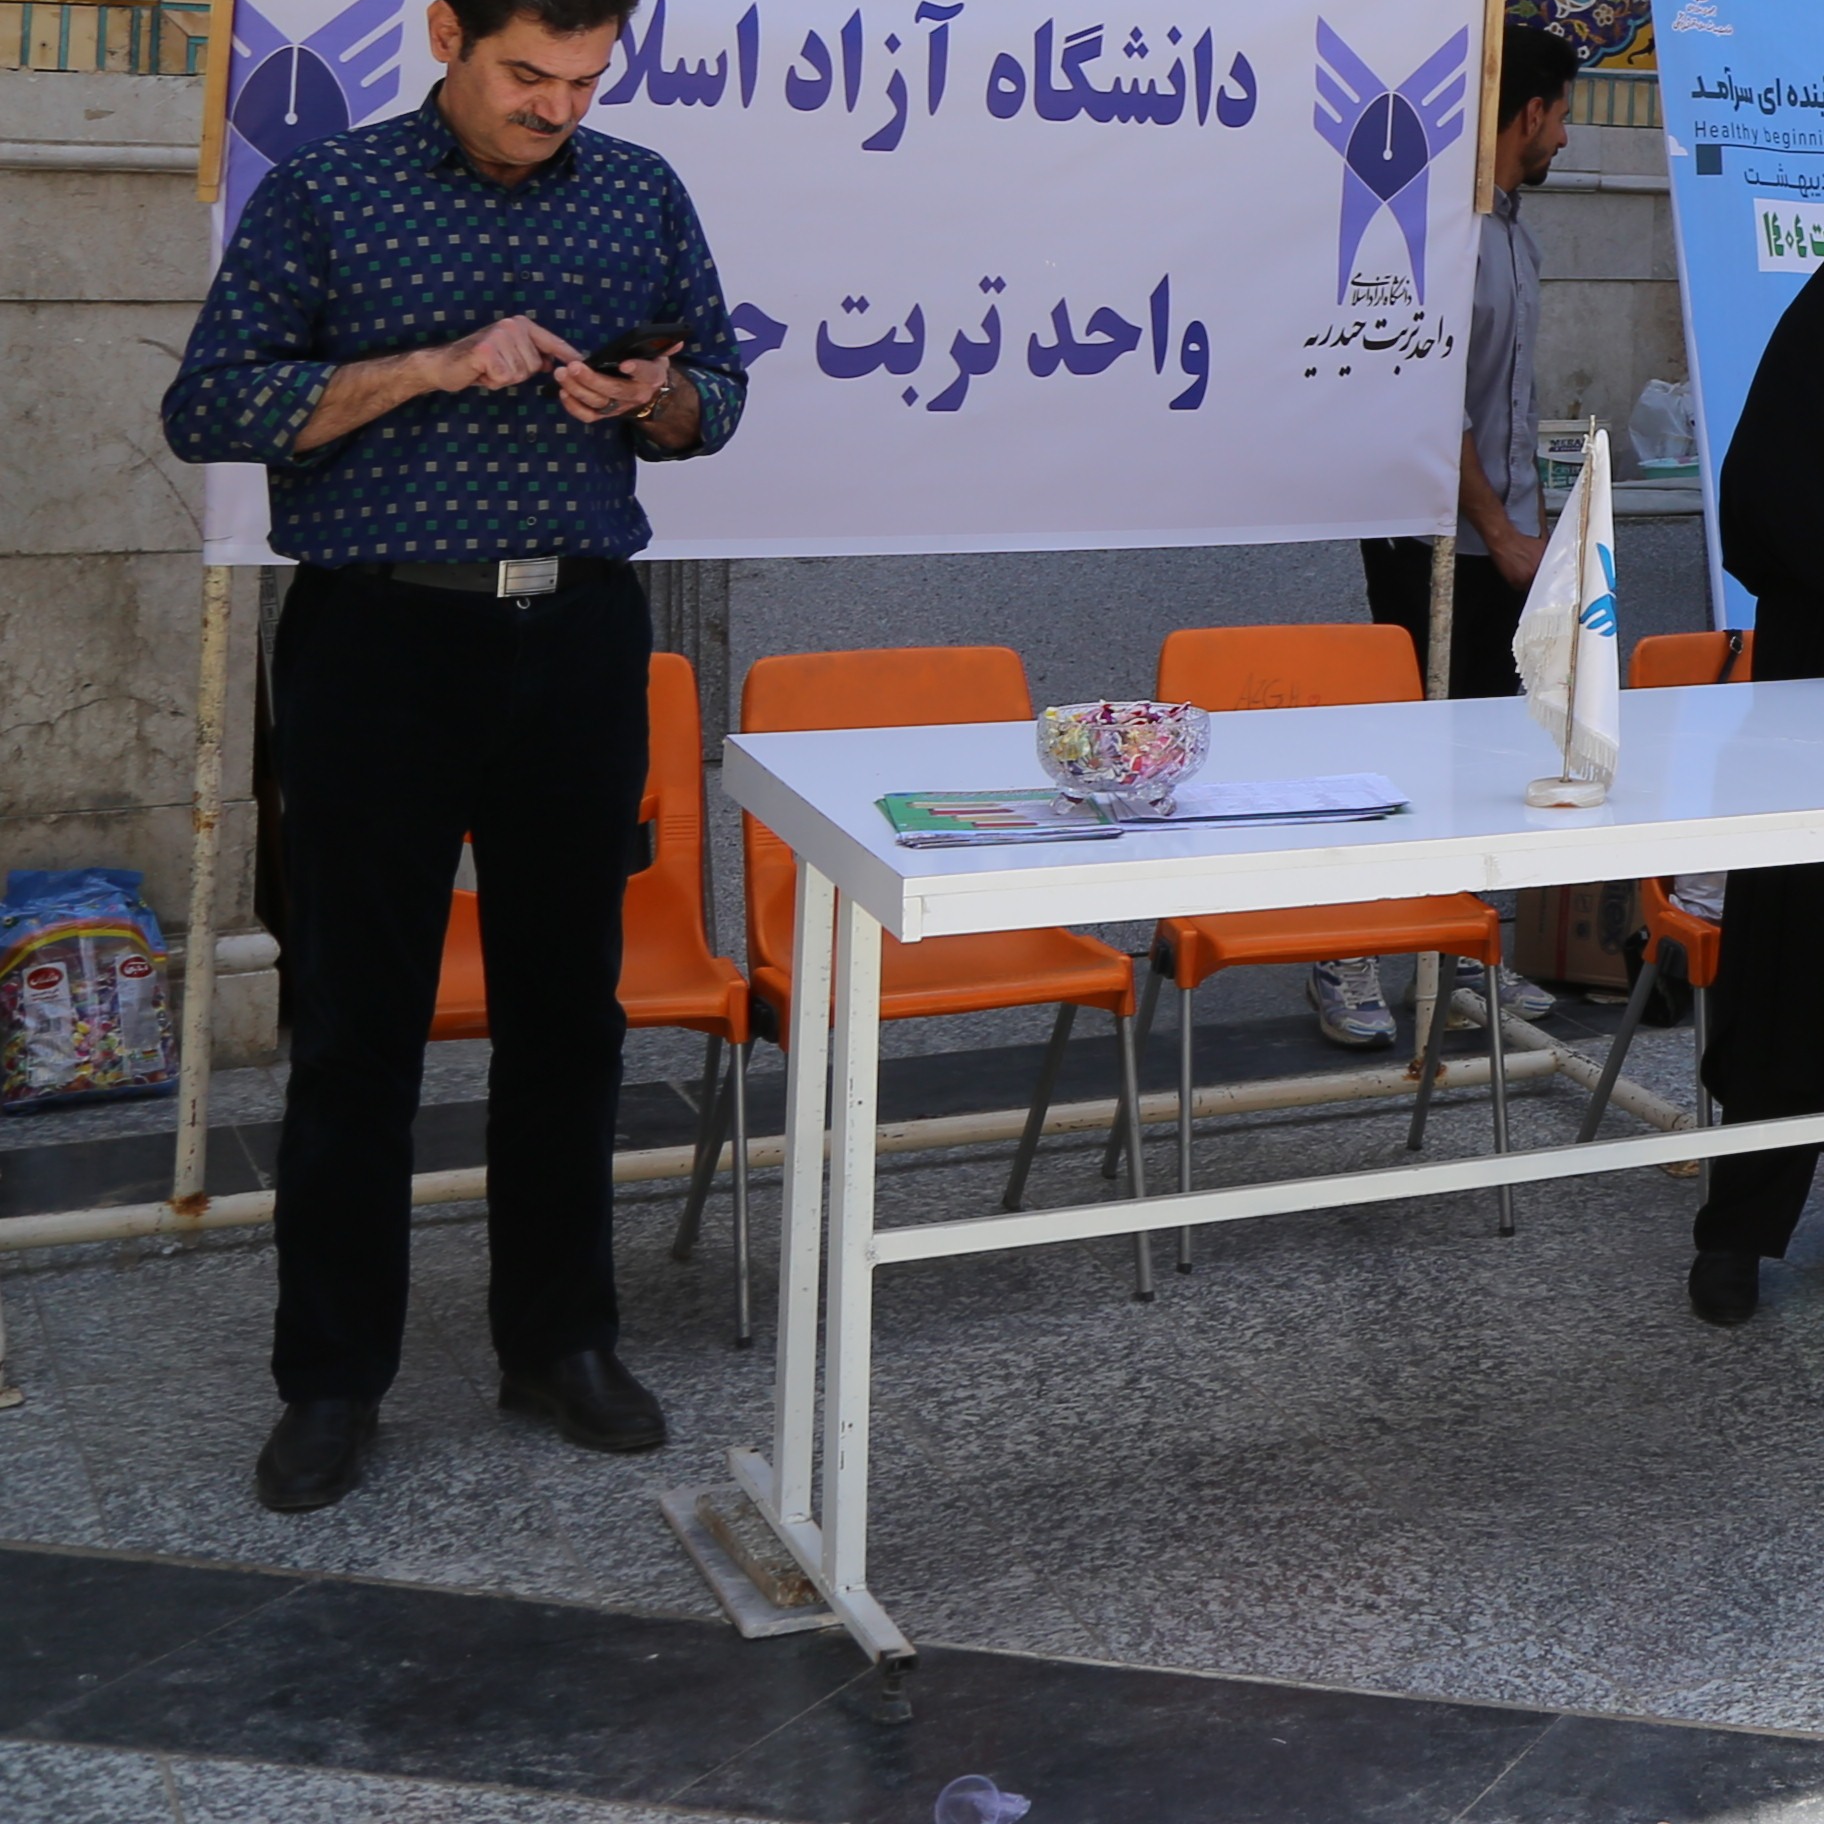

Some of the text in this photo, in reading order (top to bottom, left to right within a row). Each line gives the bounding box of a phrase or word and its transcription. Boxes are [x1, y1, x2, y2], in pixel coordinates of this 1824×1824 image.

[786, 1, 962, 152] آزاد
[987, 26, 1259, 130] دانشگاه
[1691, 67, 1753, 104] سرآمد
[1757, 78, 1781, 116] ای
[1694, 121, 1759, 145] Healthy
[814, 275, 1007, 413] تربت
[1025, 278, 1214, 410] واحد
[1303, 311, 1454, 378] واحد تربت حیدریه
